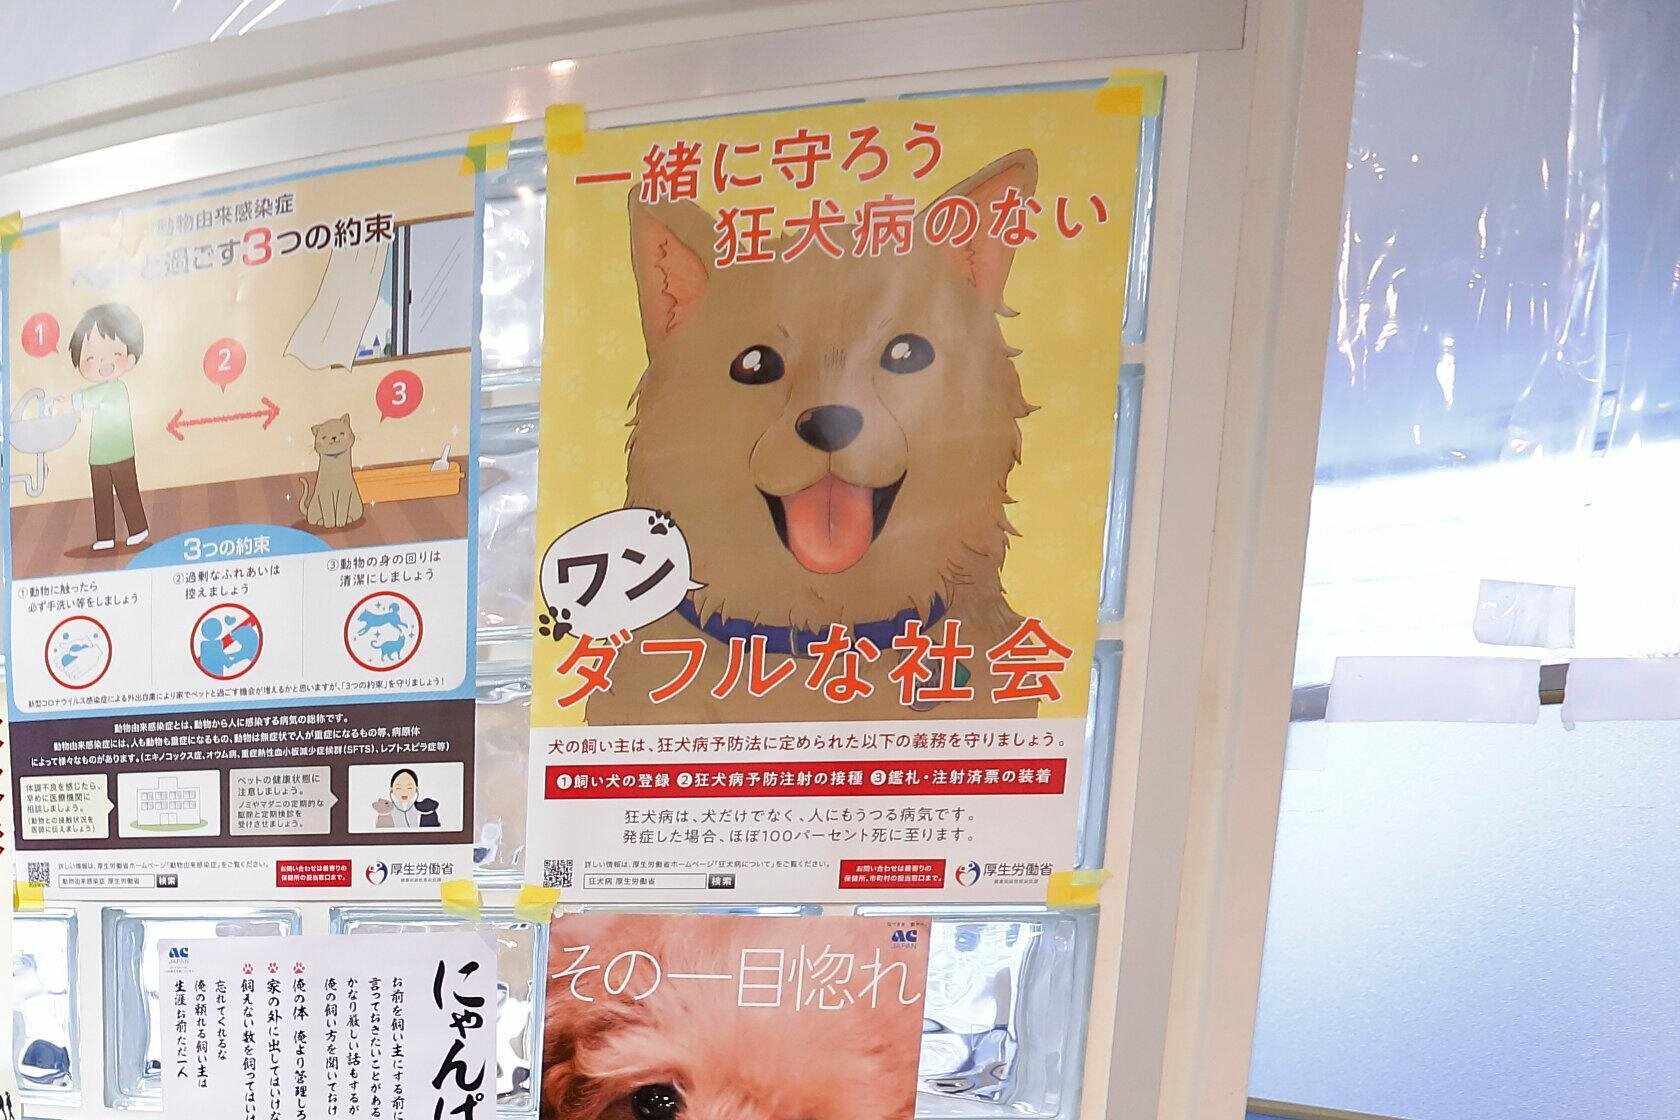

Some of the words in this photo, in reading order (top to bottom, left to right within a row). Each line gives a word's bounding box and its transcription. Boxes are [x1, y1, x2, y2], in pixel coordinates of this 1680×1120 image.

[574, 120, 944, 205] 一緒に守ろう
[713, 185, 1110, 269] 狂犬病のない
[390, 381, 409, 405] 3
[182, 535, 272, 562] 3つの約束
[338, 569, 435, 588] 清潔にしましょう
[557, 548, 675, 607] ワン
[184, 583, 250, 600] 控えましょう
[556, 618, 1074, 708] ダフルな社会
[624, 806, 976, 824] 狂犬病は、犬だけでなく、人にもうつる病気です。
[389, 861, 454, 878] 厚生労働省
[983, 862, 1053, 877] 厚生労働省
[551, 944, 922, 1011] その一目惚れ
[194, 979, 210, 1089] 俺の頼れる飼い主は
[215, 979, 228, 1062] 忘れてくれるな
[323, 977, 339, 1117] 俺の飼い方を聞いておけ
[346, 977, 361, 1117] かなり厳しい話もするが
[367, 976, 382, 1119] 言っておきたいことがある
